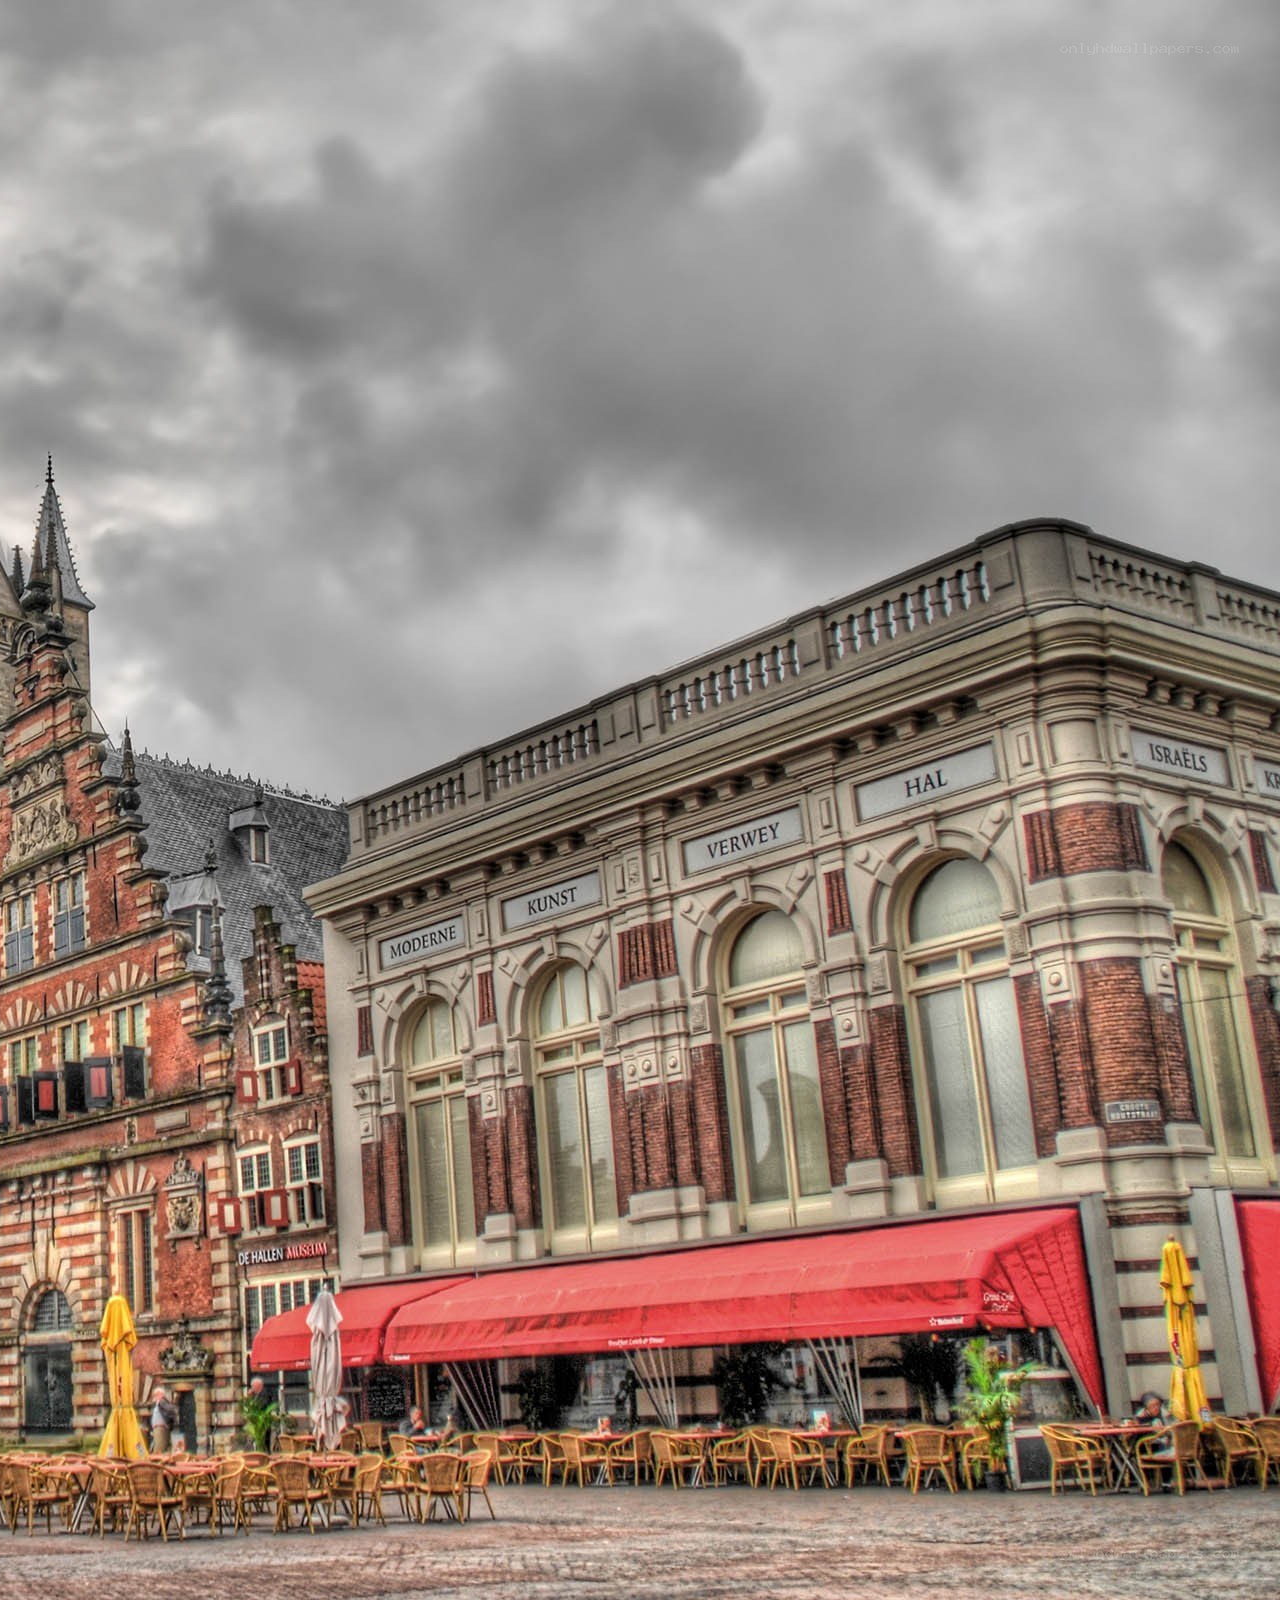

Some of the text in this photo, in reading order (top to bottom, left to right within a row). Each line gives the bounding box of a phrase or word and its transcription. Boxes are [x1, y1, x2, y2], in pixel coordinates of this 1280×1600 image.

[1148, 743, 1208, 774] ISRAËLS
[905, 770, 948, 798] HAL
[706, 822, 781, 859] VERWEY
[526, 886, 578, 916] KUNST
[389, 924, 458, 960] MODERNE
[238, 1242, 328, 1265] DE HALLEN MUSEUM
